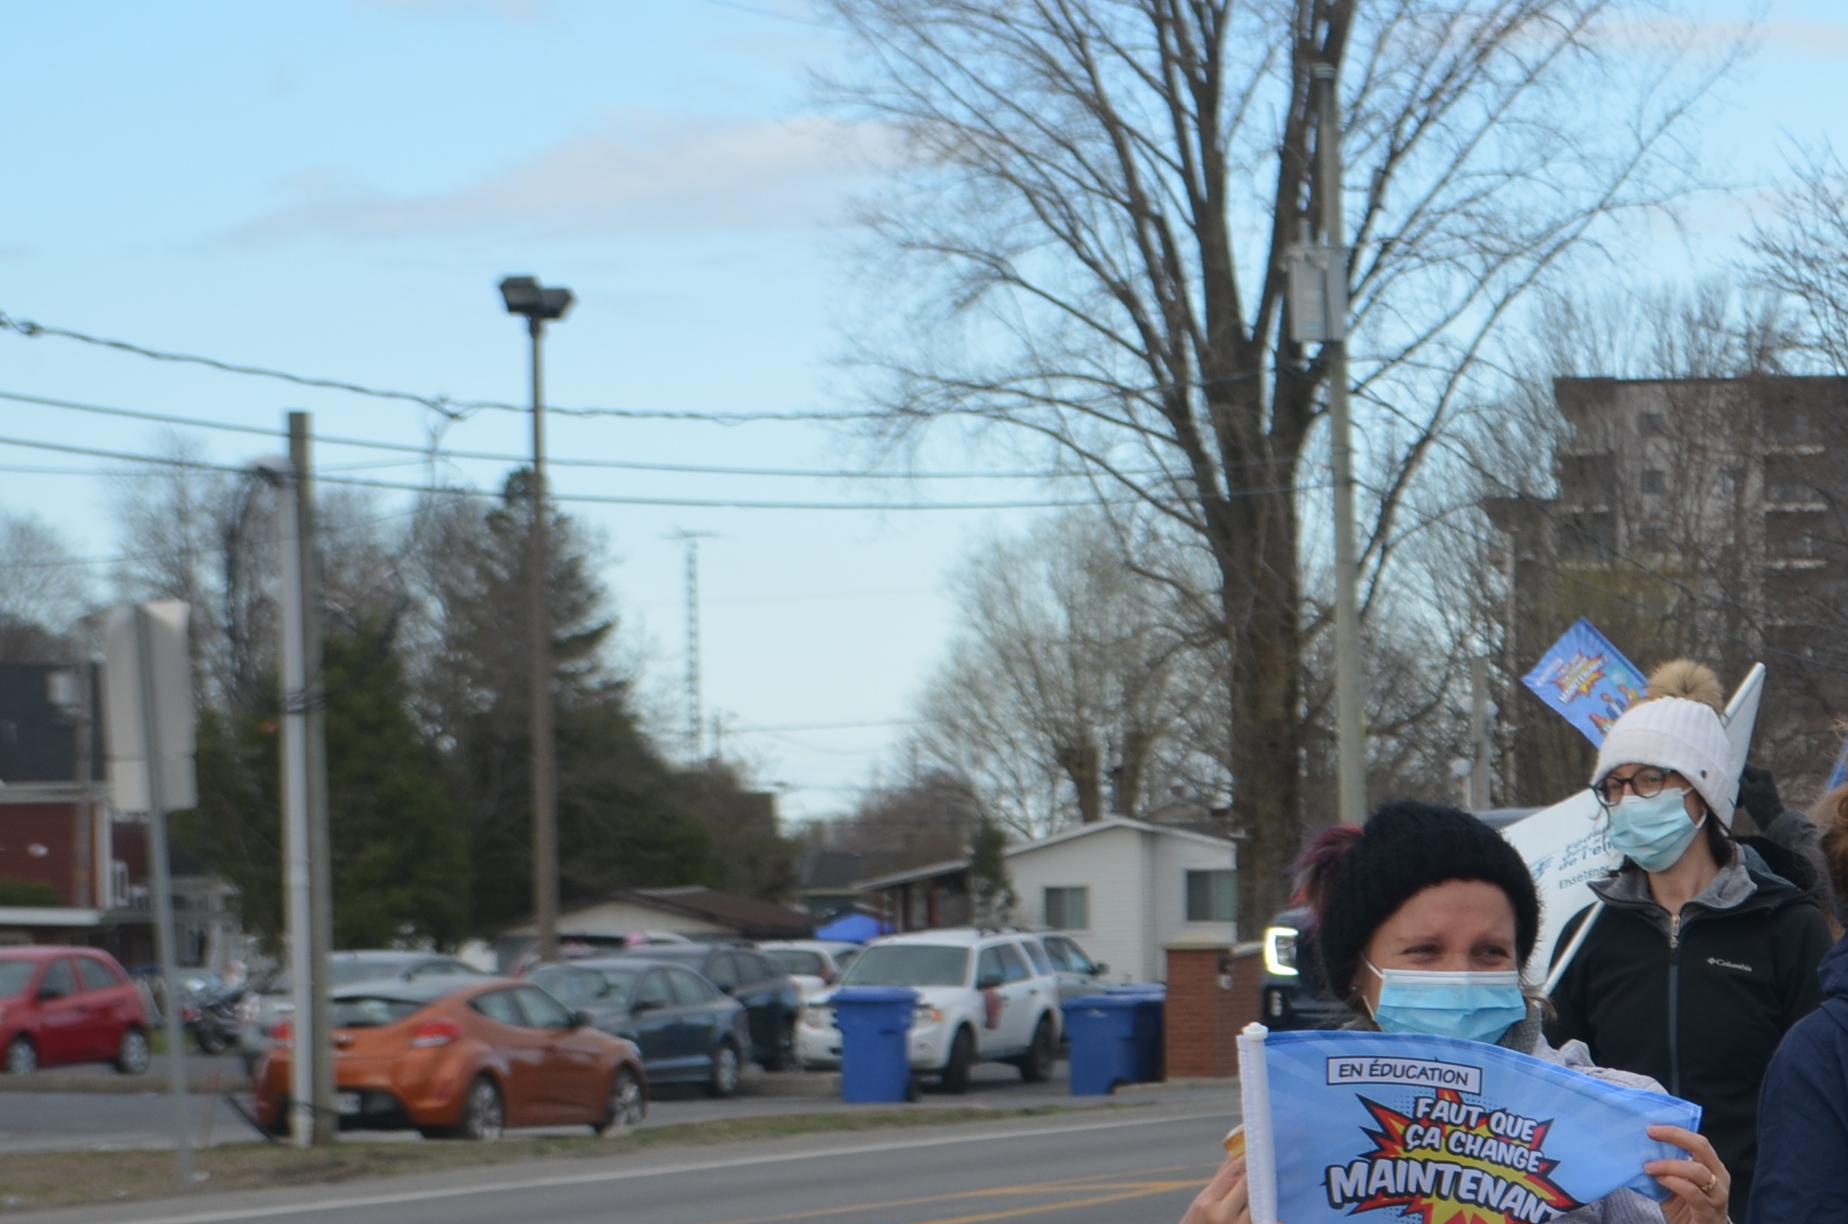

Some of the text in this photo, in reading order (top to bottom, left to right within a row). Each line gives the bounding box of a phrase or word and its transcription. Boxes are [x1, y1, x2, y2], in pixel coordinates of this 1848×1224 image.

[1338, 1057, 1470, 1087] EN ÉDUCATION
[1413, 1097, 1539, 1143] FAUT QUE
[1403, 1122, 1546, 1174] ÇA CHANGE
